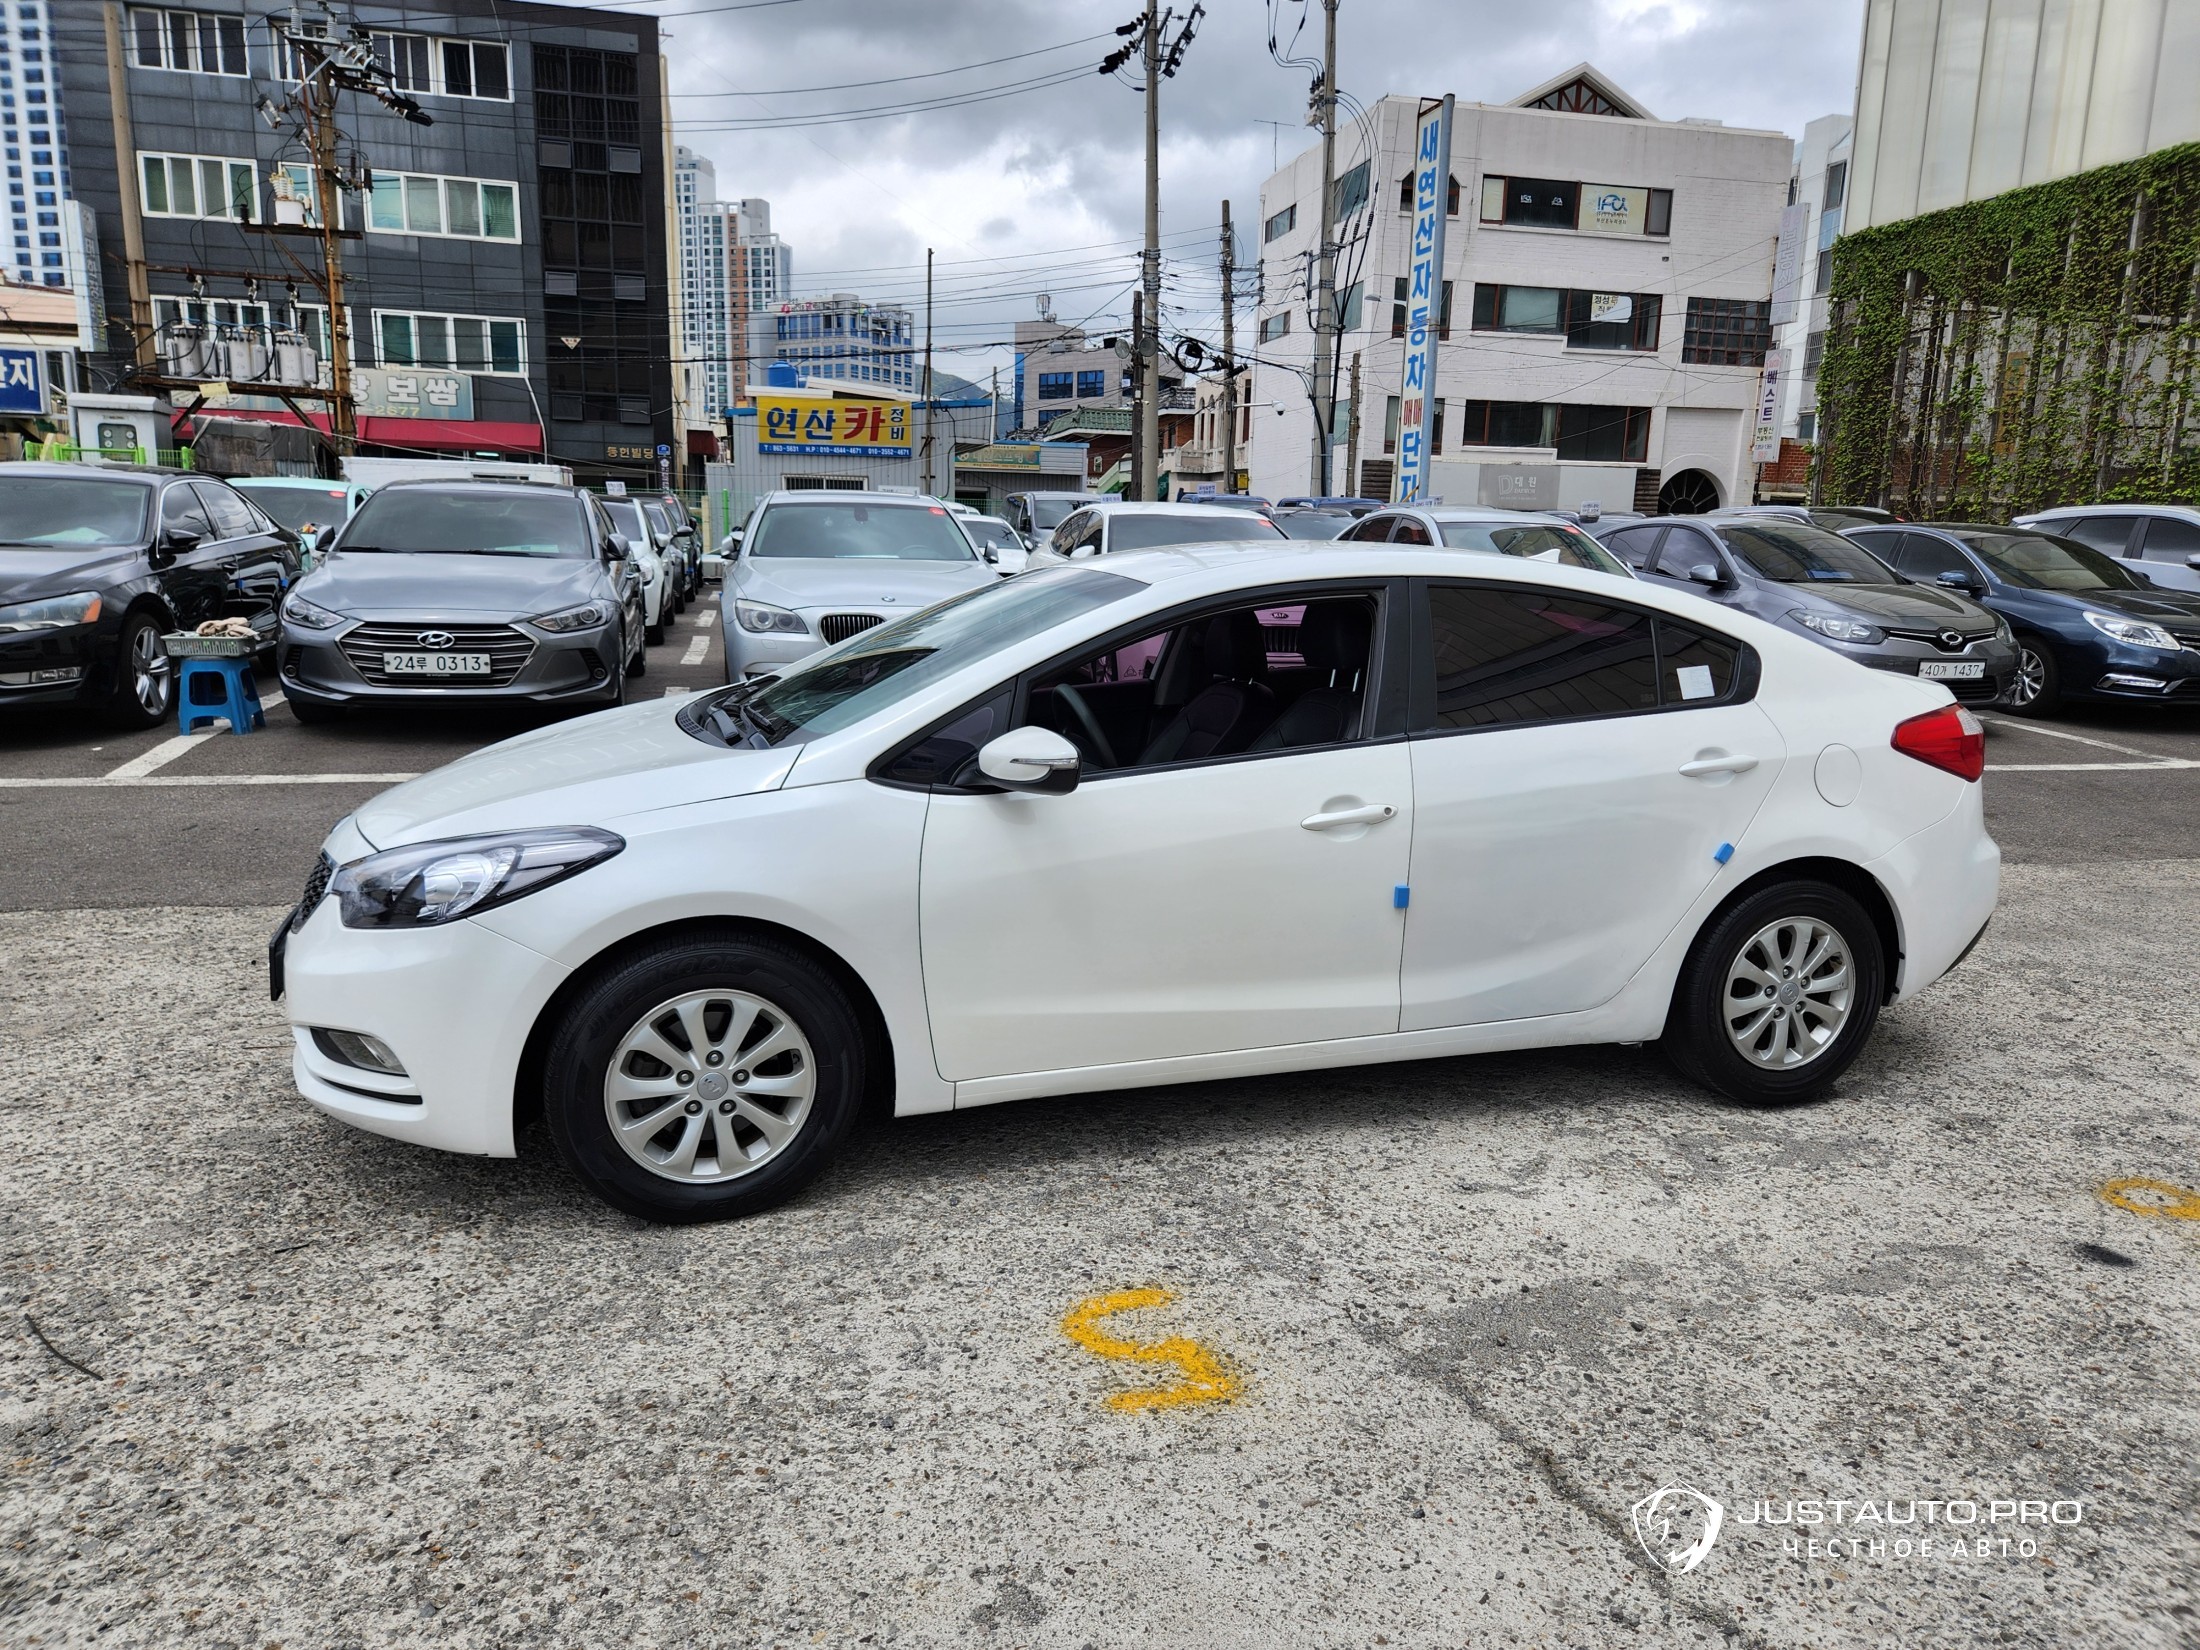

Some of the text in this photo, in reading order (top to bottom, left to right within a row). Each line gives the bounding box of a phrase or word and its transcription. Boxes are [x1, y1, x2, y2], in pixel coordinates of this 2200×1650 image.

[386, 375, 461, 407] 보쌈
[1762, 369, 1778, 421] 베스트
[890, 408, 905, 441] 정비
[393, 655, 482, 671] 24루 0313
[1953, 664, 1980, 676] 1437
